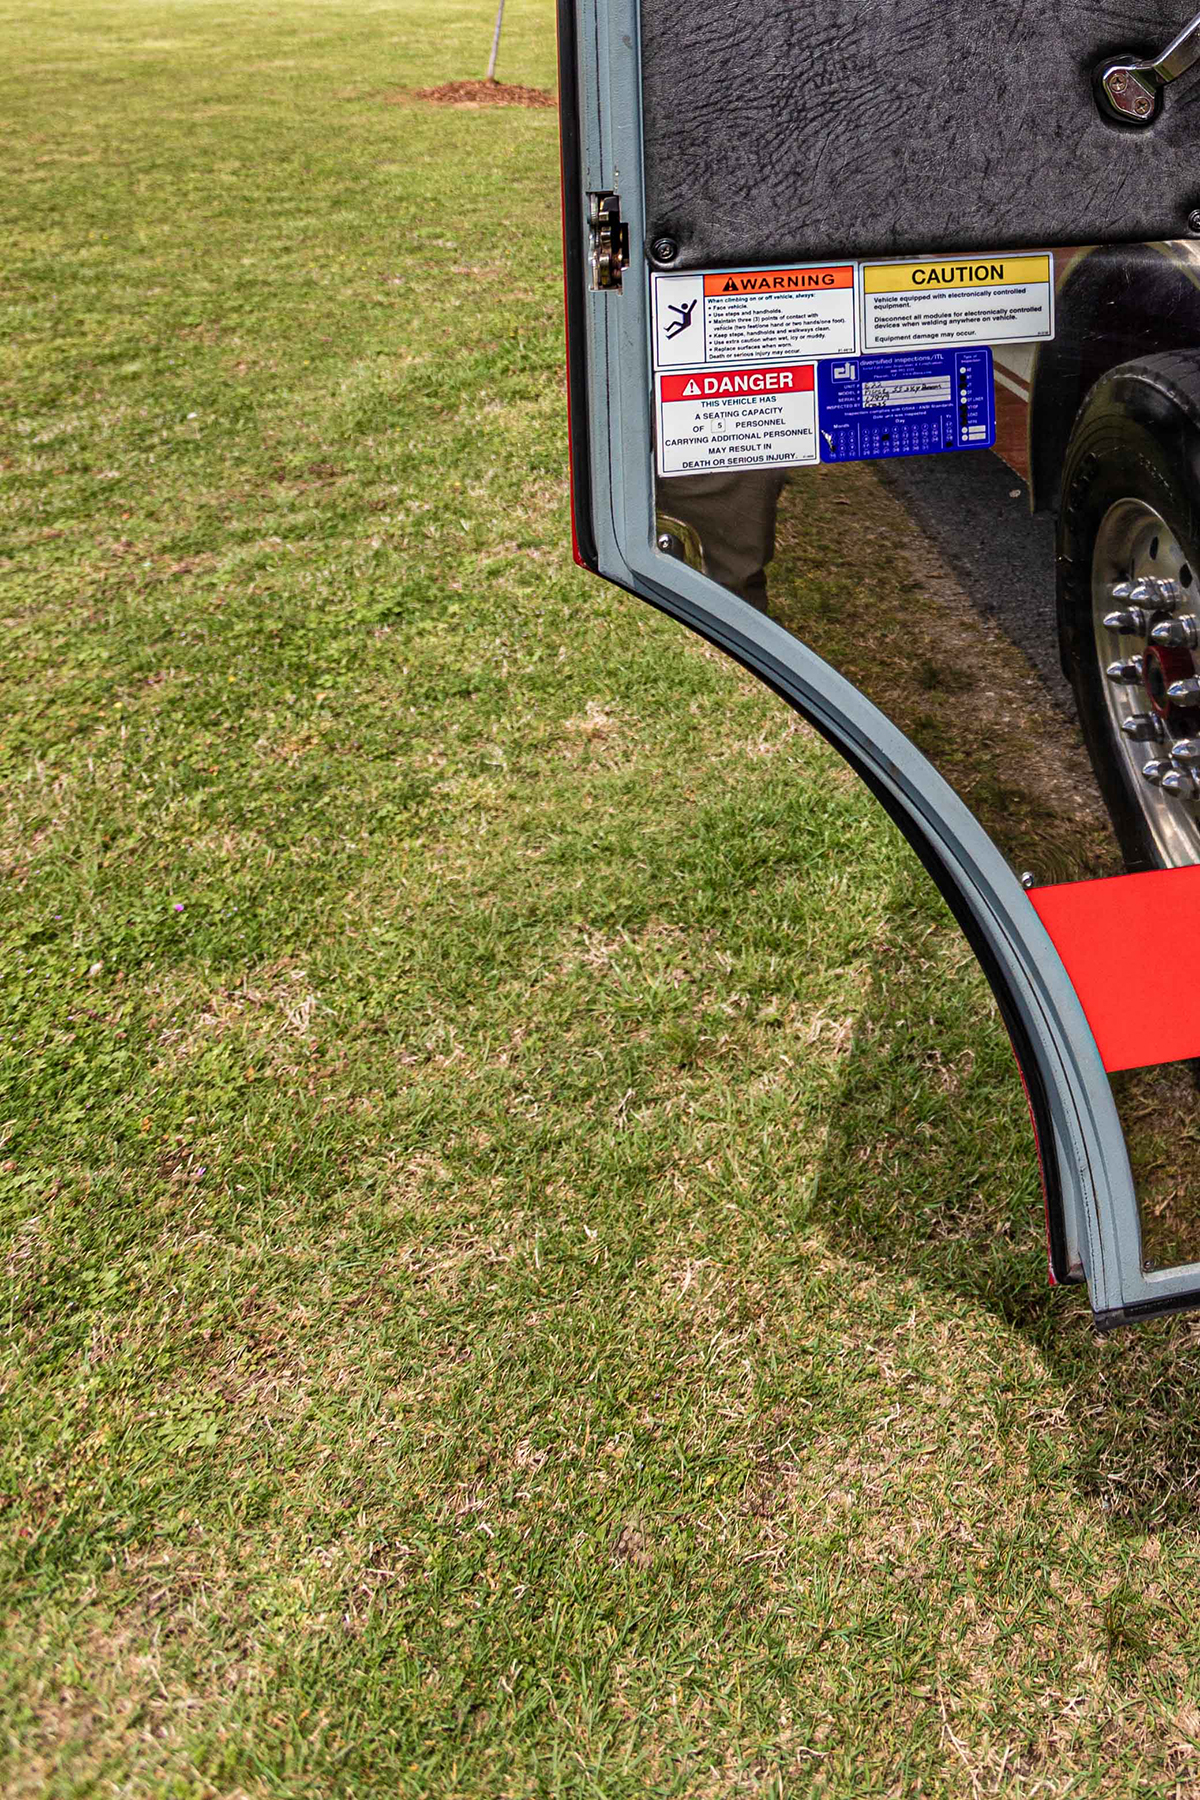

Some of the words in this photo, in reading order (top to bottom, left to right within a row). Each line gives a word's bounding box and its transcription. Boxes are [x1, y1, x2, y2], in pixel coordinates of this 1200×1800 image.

[911, 264, 1004, 285] CAUTION
[740, 273, 835, 291] WARNING
[899, 294, 931, 303] equipped
[948, 290, 991, 298] electronically
[874, 302, 911, 310] equipment.
[874, 315, 912, 323] Disconnect
[964, 308, 1008, 317] electronically
[922, 318, 947, 327] welding
[949, 317, 980, 326] anywhere
[875, 335, 911, 343] Equipment
[913, 333, 939, 341] damage
[704, 371, 794, 394] DANGER
[722, 397, 757, 406] VEHICLE
[703, 410, 739, 420] SEATING
[742, 407, 783, 416] CAPACITY
[736, 419, 786, 428] PERSONNEL
[665, 436, 709, 447] CARRYING
[711, 433, 761, 443] ADDITIONAL
[763, 428, 813, 438] PERSONNEL
[729, 444, 761, 453] RESULT
[682, 460, 710, 469] DEATH
[727, 455, 764, 465] SERIOUS
[766, 452, 798, 462] INJURY.
